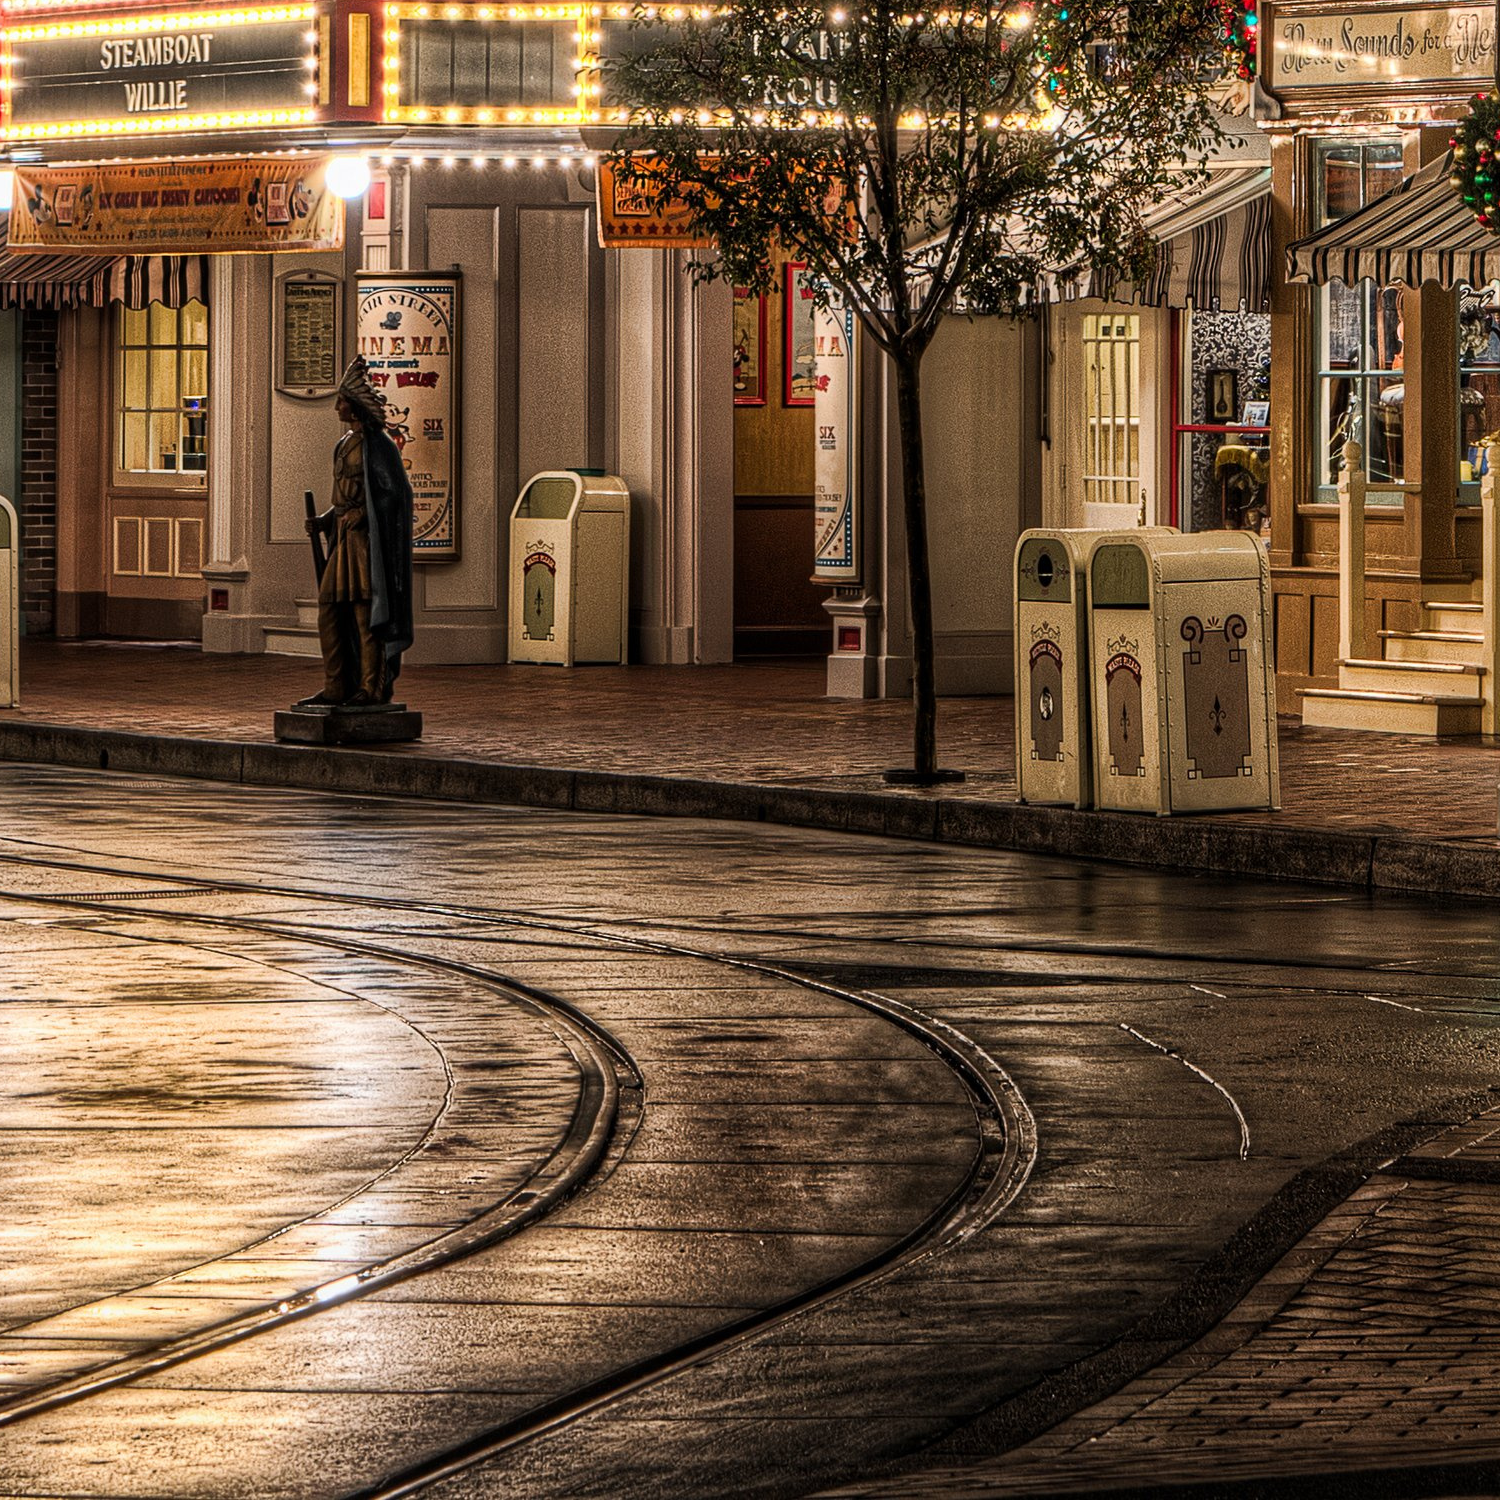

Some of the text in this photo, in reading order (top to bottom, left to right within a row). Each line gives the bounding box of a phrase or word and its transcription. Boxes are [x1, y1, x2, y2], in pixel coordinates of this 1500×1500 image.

[100, 33, 214, 70] STEAMBOAT
[1334, 16, 1418, 71] Sounds
[1420, 29, 1441, 55] for
[1454, 12, 1496, 65] Ne
[124, 80, 188, 112] WILLIE
[387, 294, 444, 328] STREET
[358, 336, 450, 356] INEMA
[423, 418, 443, 431] SIX
[819, 426, 836, 440] SIX
